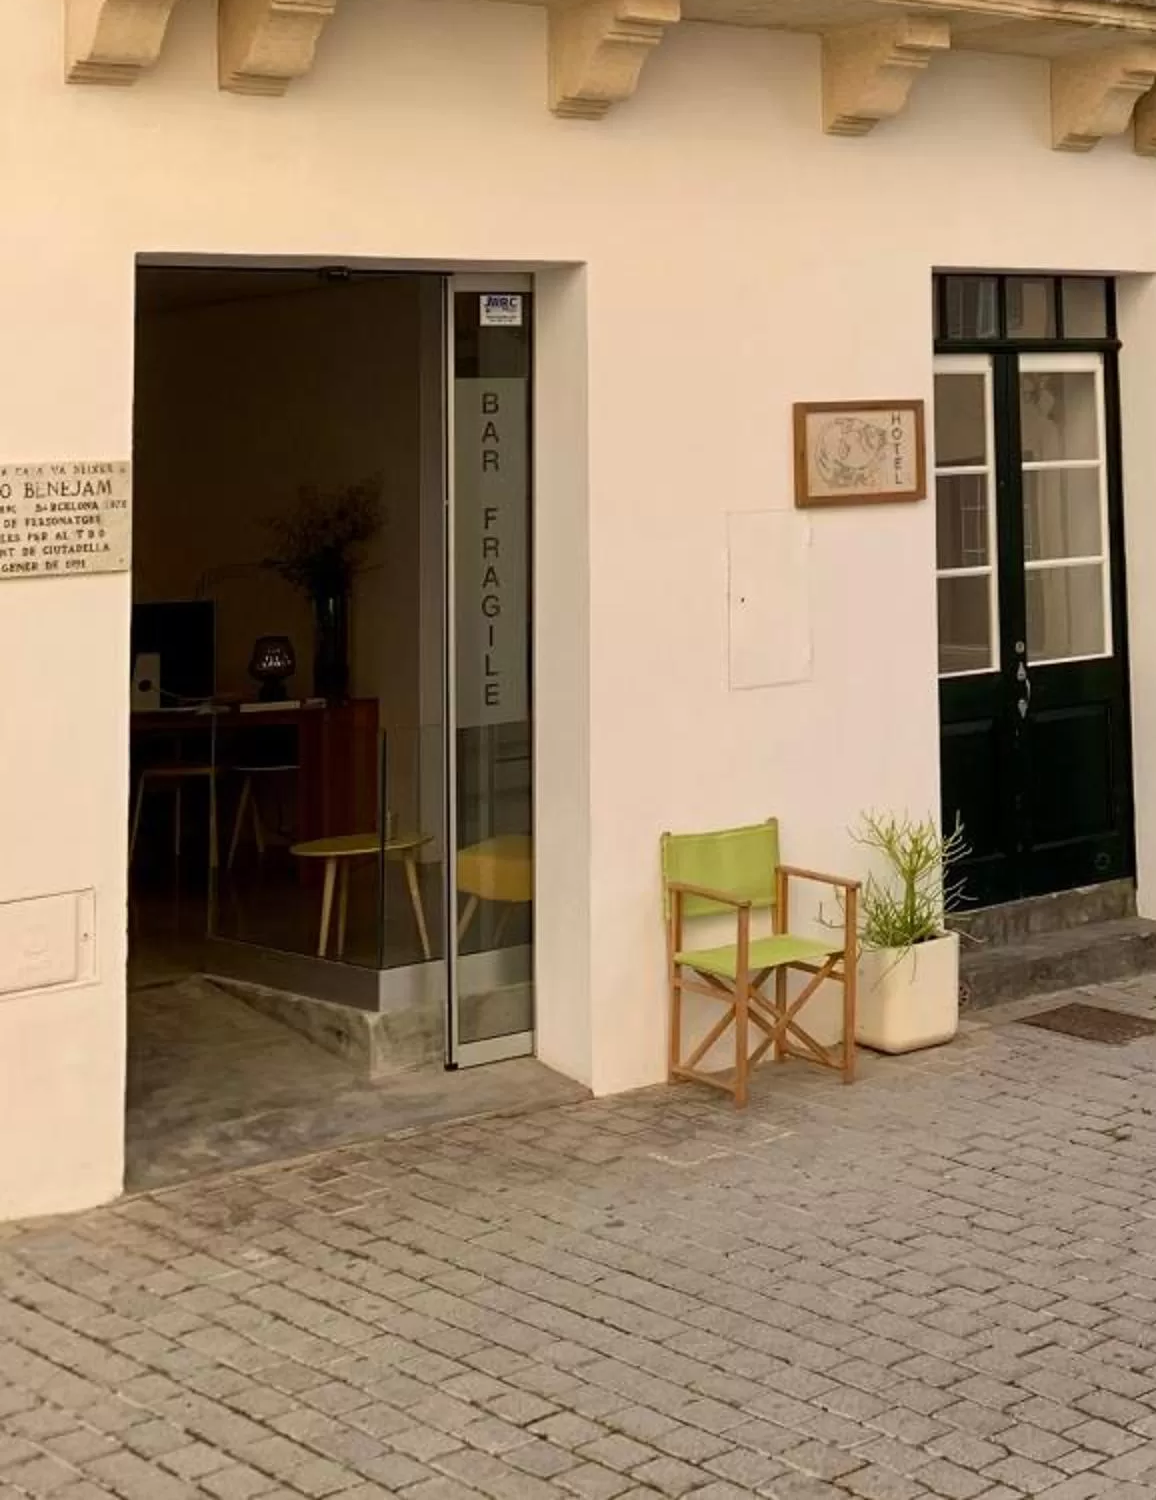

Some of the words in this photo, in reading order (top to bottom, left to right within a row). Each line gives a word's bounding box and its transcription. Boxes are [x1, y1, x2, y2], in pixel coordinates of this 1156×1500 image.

[482, 392, 500, 473] BAR
[891, 411, 903, 485] HOTEL
[24, 479, 113, 499] BENEJAM
[35, 501, 99, 513] BARCELONA
[42, 543, 111, 556] CIUTADELLA
[481, 508, 500, 706] FRAGILE
